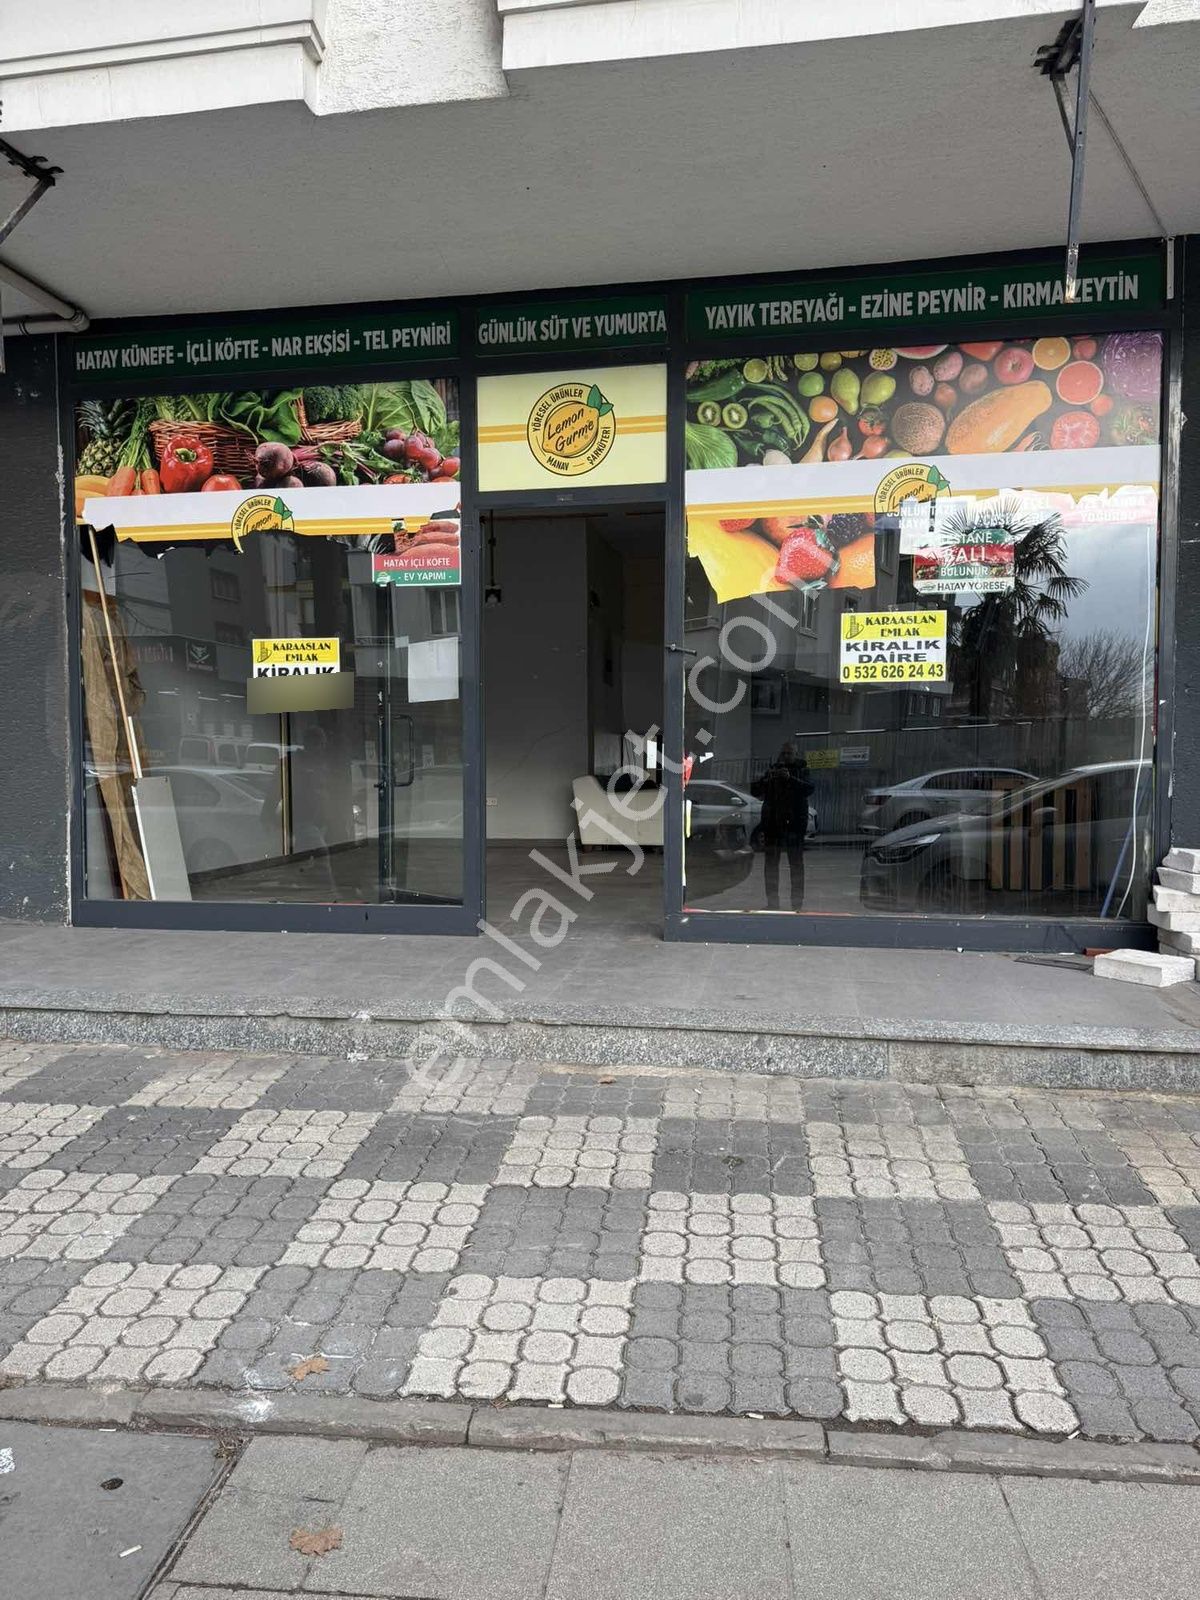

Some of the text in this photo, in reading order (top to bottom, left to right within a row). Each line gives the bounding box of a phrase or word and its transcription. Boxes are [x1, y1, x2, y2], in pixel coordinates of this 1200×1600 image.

[705, 303, 756, 330] YAYIK
[758, 292, 844, 326] TEREYAĞI
[860, 289, 914, 319] EZİNE
[918, 282, 986, 315] PEYNİR
[1003, 279, 1066, 309] KIRMA
[478, 309, 667, 345] GÜNLÜK SÜT VE YUMURTA
[76, 348, 118, 370] HATAY
[121, 344, 174, 368] KÜNEFE
[186, 339, 212, 365] İÇLİ
[215, 337, 259, 361] KÖFTE
[271, 336, 303, 357] NAR
[305, 328, 351, 356] EKŞİSİ
[363, 330, 389, 350] TEL
[392, 321, 451, 348] PEYNİRİ
[533, 388, 584, 433] YÖRESEL ÜRÜNLER
[548, 408, 584, 440] Lemon
[555, 420, 594, 452] Gurme
[546, 456, 570, 471] MANAV
[383, 559, 409, 568] HATAY
[404, 572, 415, 581] EV
[417, 571, 446, 581] YAPIMI
[937, 582, 967, 592] HATAY
[865, 615, 937, 626] KARAASLAN
[880, 628, 920, 638] EMLAK
[273, 642, 332, 652] KARAASLAN
[846, 640, 941, 652] KİRALIK
[285, 653, 318, 662] EMLAK
[858, 652, 927, 663] DAİRE
[843, 663, 944, 680] 0 532 626 24 43
